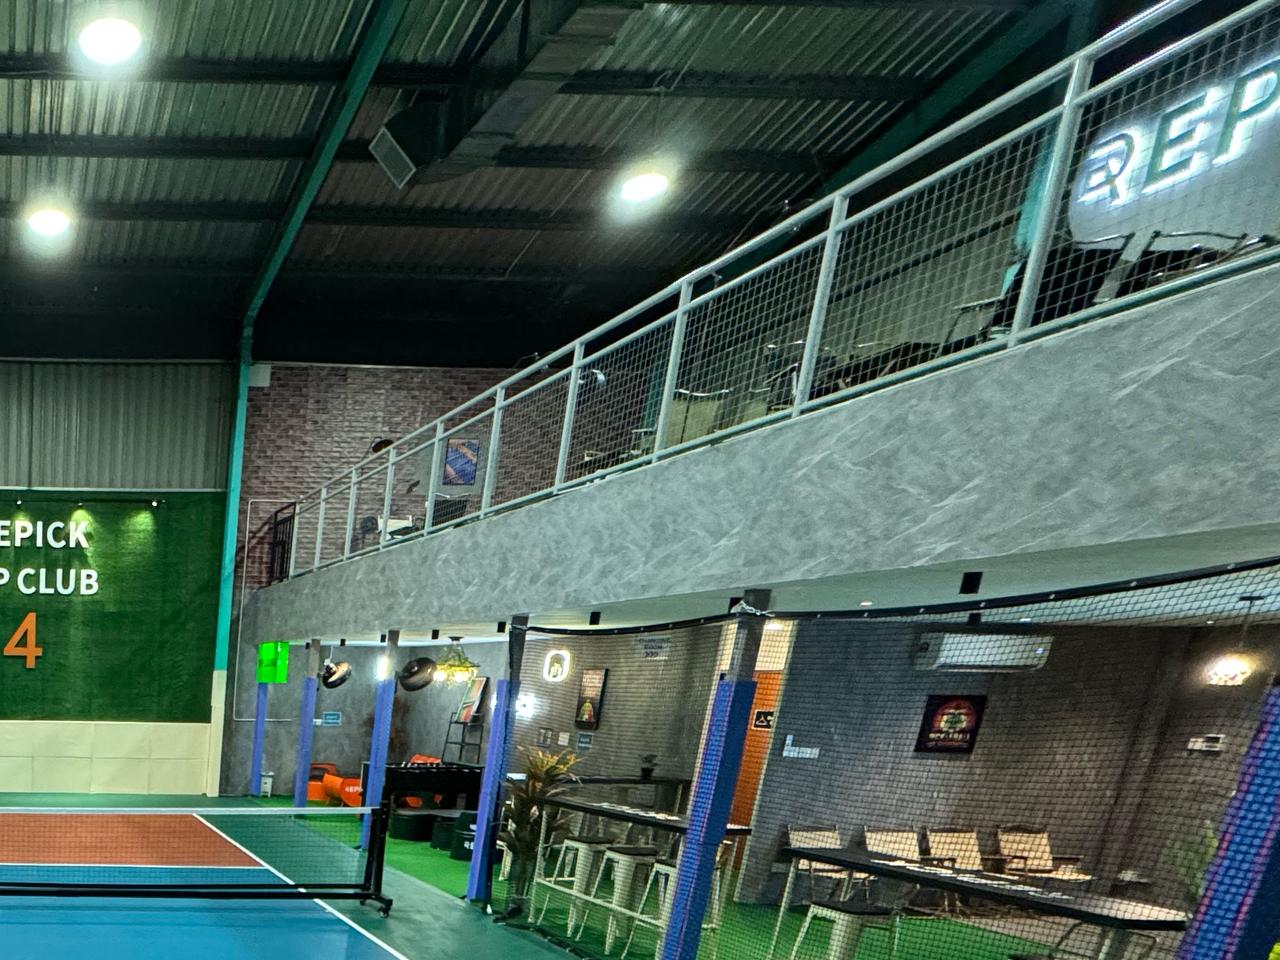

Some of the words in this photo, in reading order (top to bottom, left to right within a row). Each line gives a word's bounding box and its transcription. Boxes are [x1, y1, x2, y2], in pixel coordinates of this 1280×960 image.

[1077, 57, 1280, 206] REP
[17, 567, 100, 596] CLUB
[2, 611, 44, 669] 4
